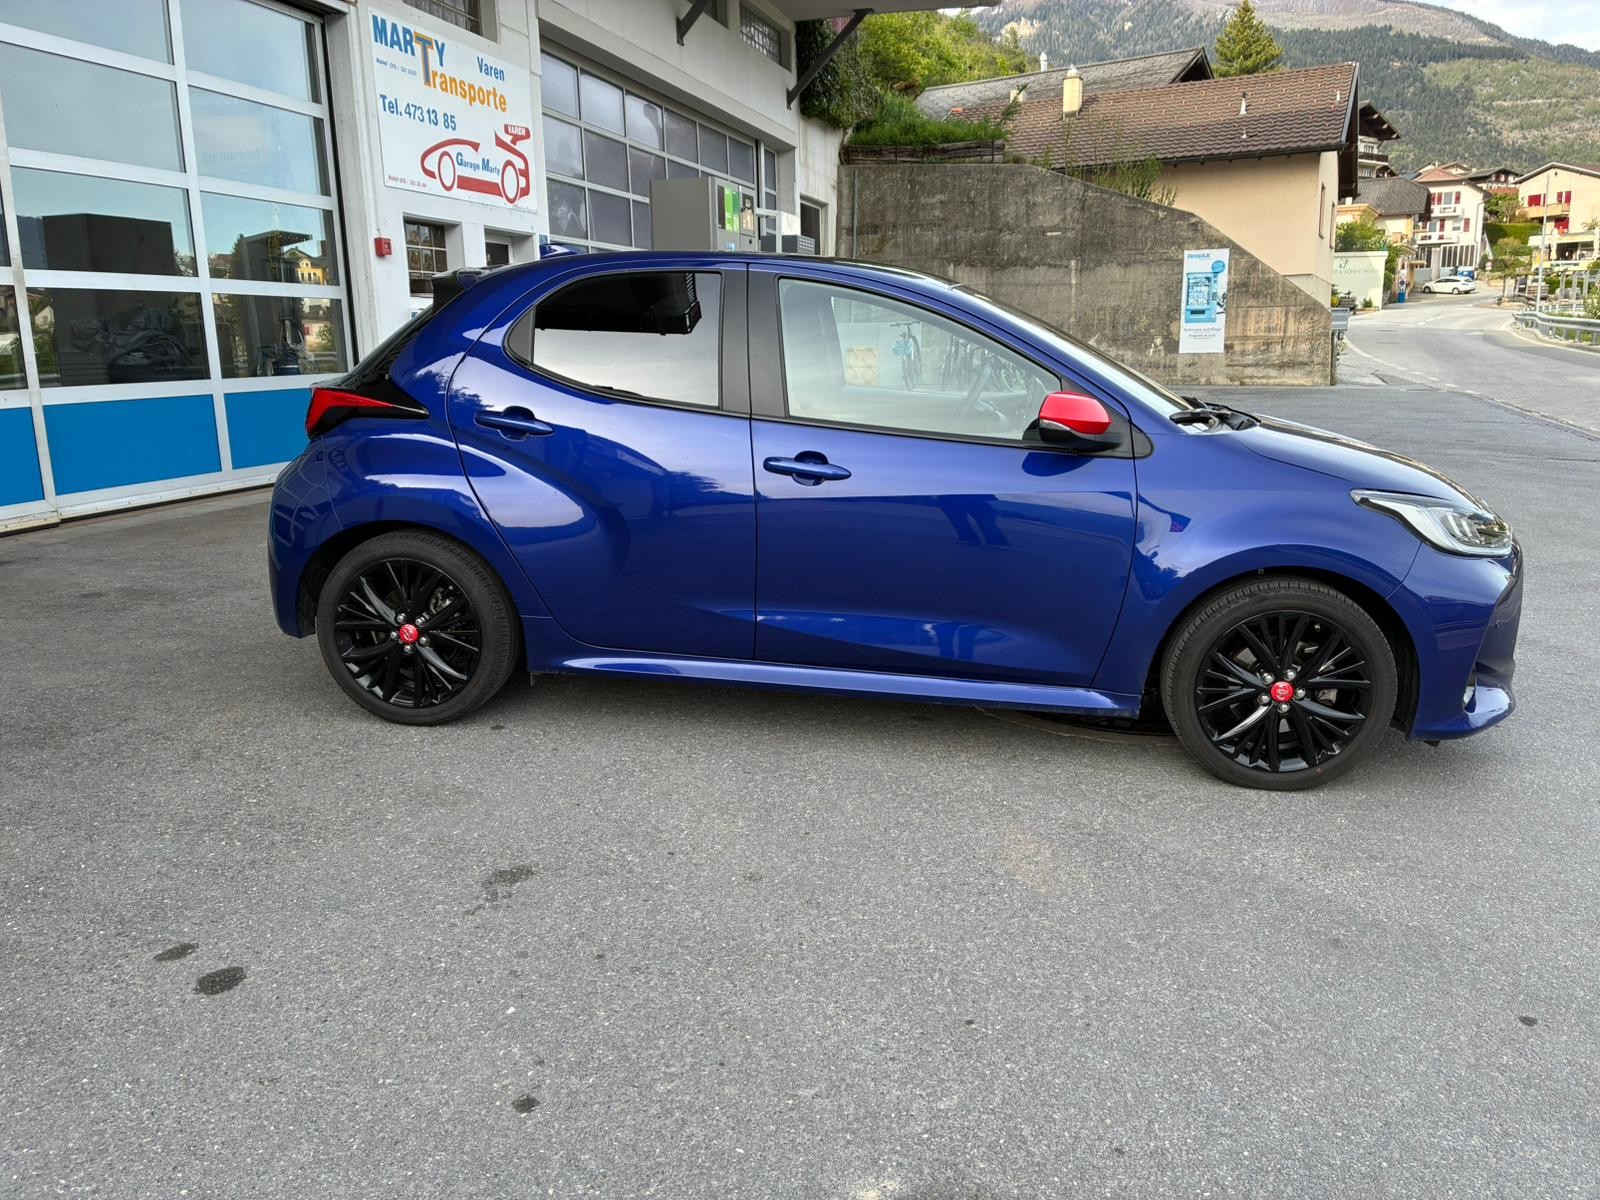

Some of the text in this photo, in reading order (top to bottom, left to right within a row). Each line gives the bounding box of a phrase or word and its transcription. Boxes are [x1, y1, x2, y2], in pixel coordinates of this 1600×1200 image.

[372, 14, 446, 86] MARTY
[477, 56, 505, 82] Varen
[443, 114, 457, 131] 85
[507, 125, 526, 136] VAREN
[456, 152, 500, 176] Garage Marty
